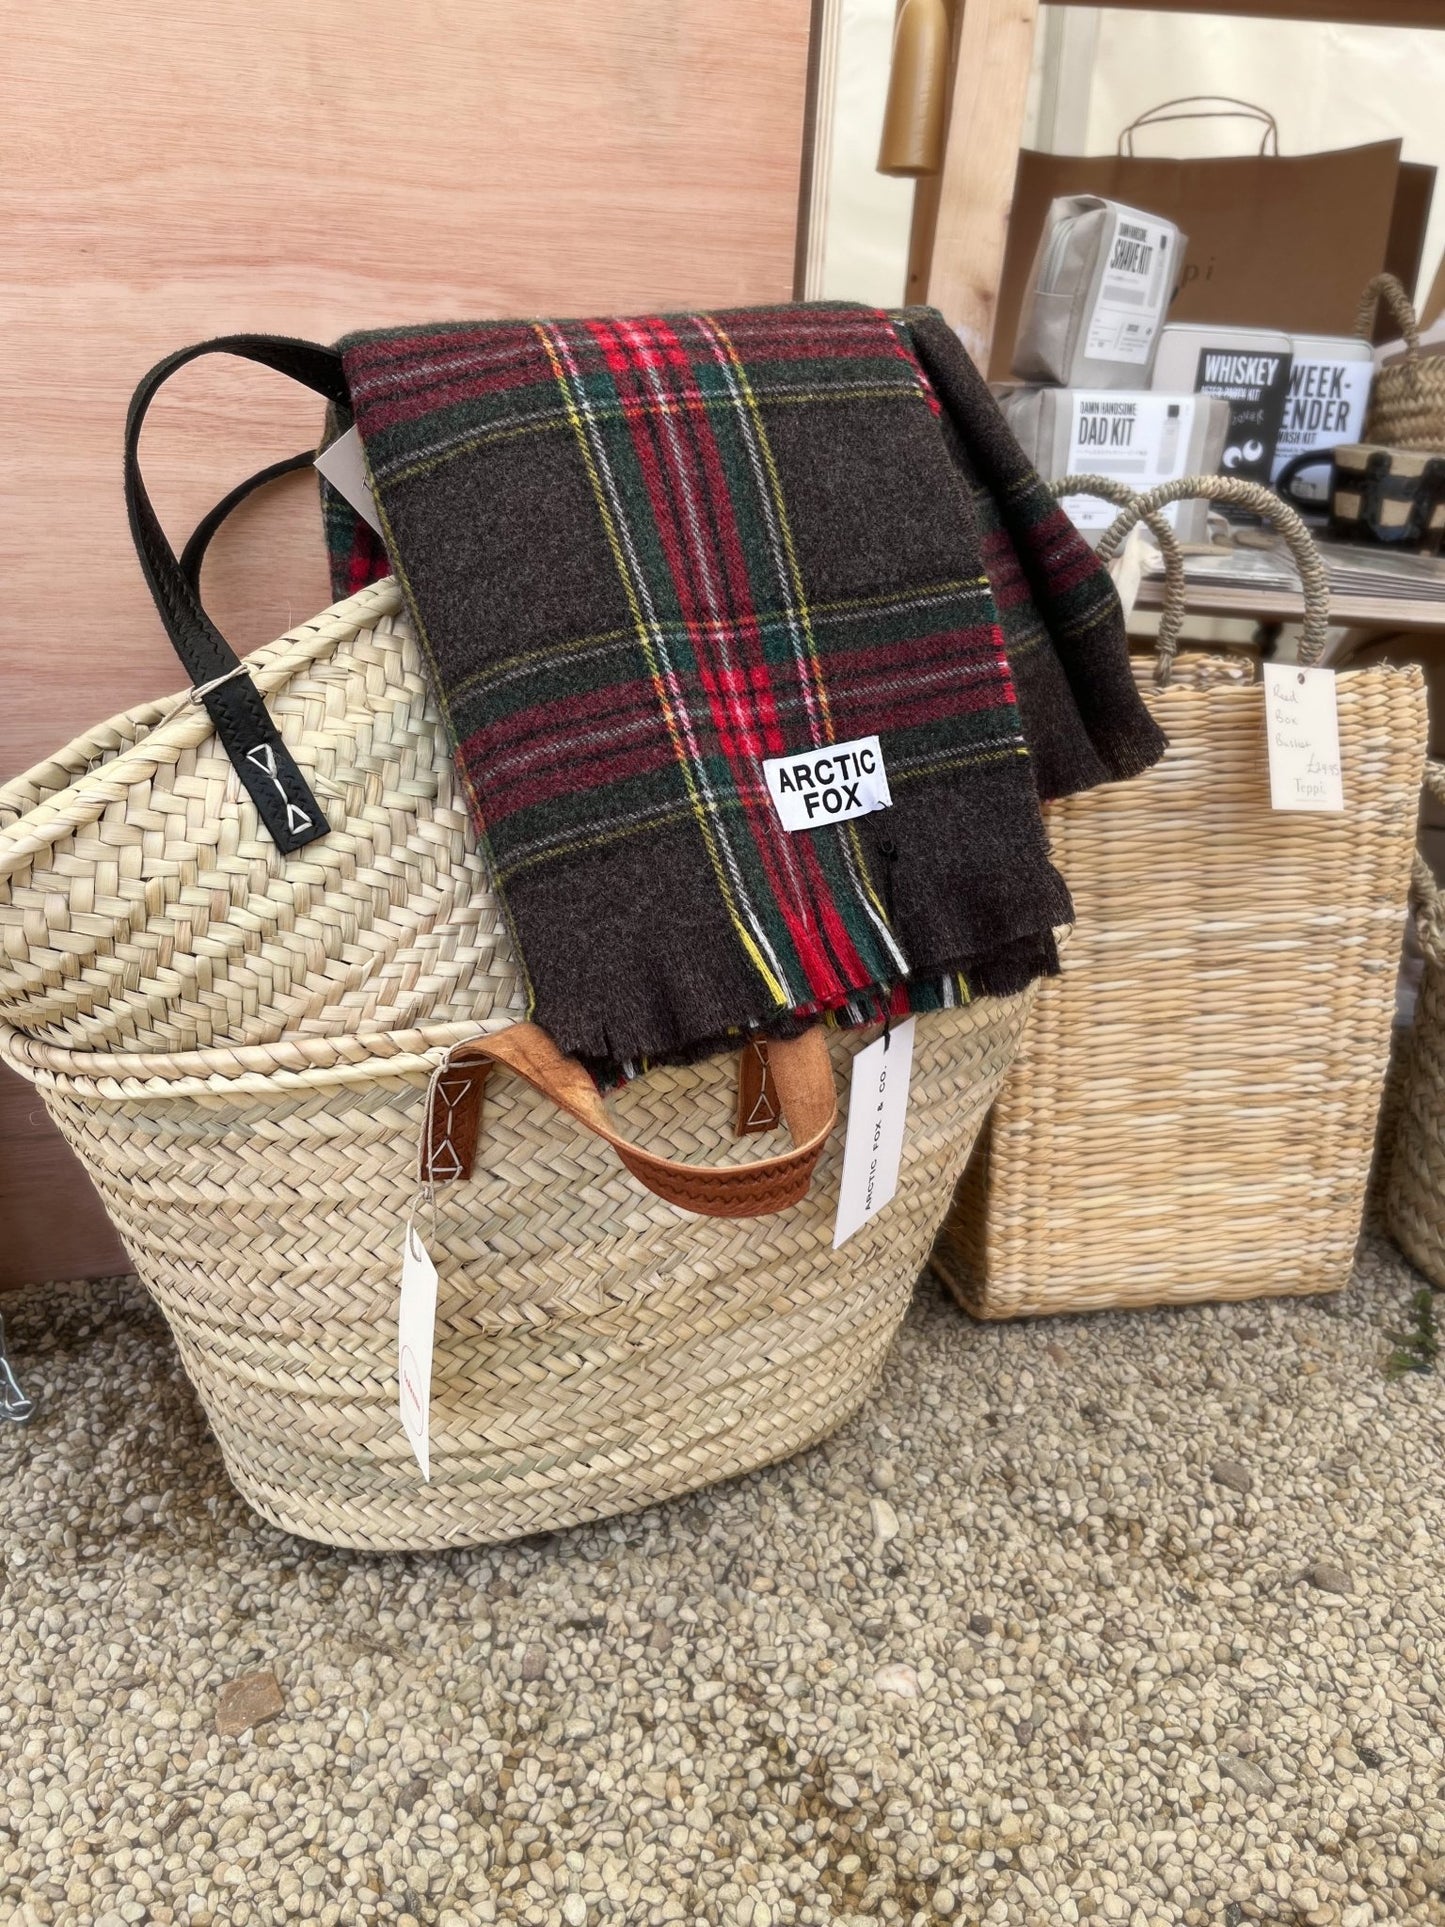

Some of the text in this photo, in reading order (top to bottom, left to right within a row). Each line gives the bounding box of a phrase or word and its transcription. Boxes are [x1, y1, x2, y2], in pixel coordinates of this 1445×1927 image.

[1110, 238, 1153, 275] SHAVE KIT
[1204, 354, 1280, 386] WHISKEY
[1288, 364, 1352, 399] WEEK-
[1080, 401, 1137, 416] DAMN HANDSOME
[1246, 387, 1261, 402] KIT
[1280, 398, 1351, 432] ENDER
[1078, 417, 1136, 446] DAD KIT
[1301, 432, 1317, 444] KIT
[1274, 708, 1298, 726] Box
[779, 749, 876, 793] ARCTIC
[1293, 777, 1327, 797] Teppi
[803, 782, 863, 819] FOX
[865, 1065, 887, 1211] ARCTIC FOX & CO.
